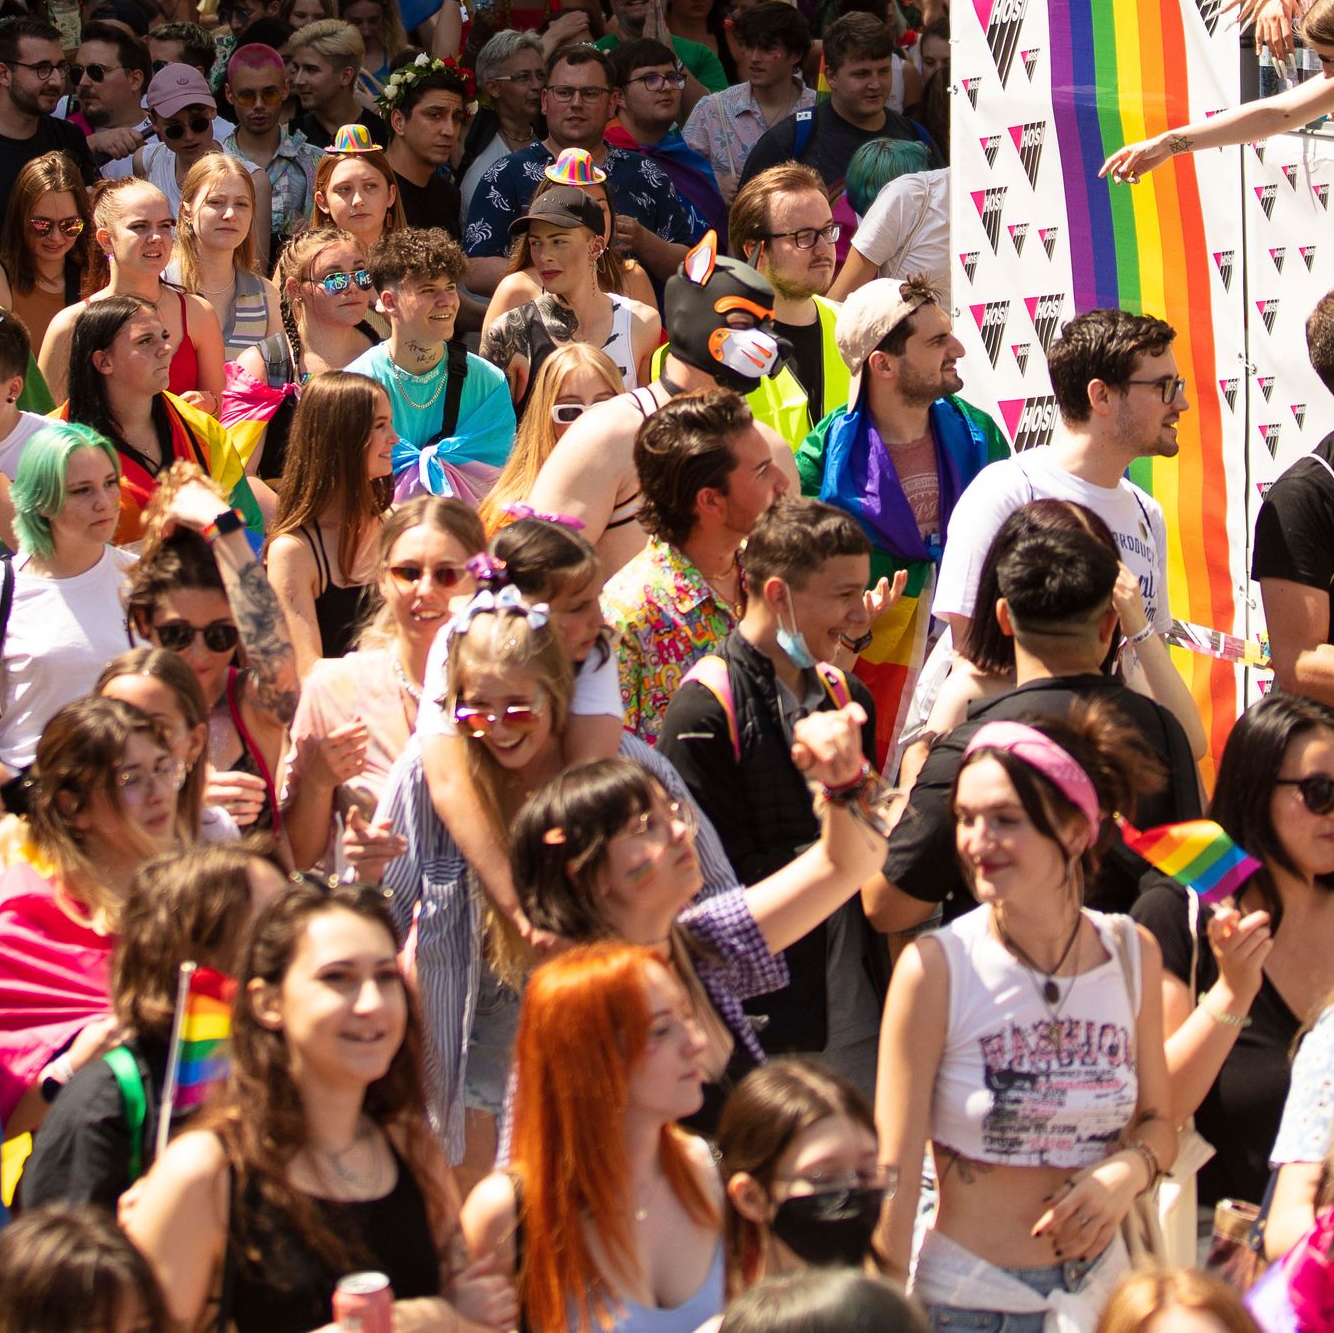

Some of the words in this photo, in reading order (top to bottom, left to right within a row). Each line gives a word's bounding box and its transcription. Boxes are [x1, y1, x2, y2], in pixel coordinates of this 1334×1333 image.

[1021, 125, 1045, 150] HOSI
[983, 191, 1007, 216] HOSI
[983, 304, 1009, 329] HOSI
[1035, 296, 1064, 321] HOSI
[1018, 403, 1059, 433] HOSI
